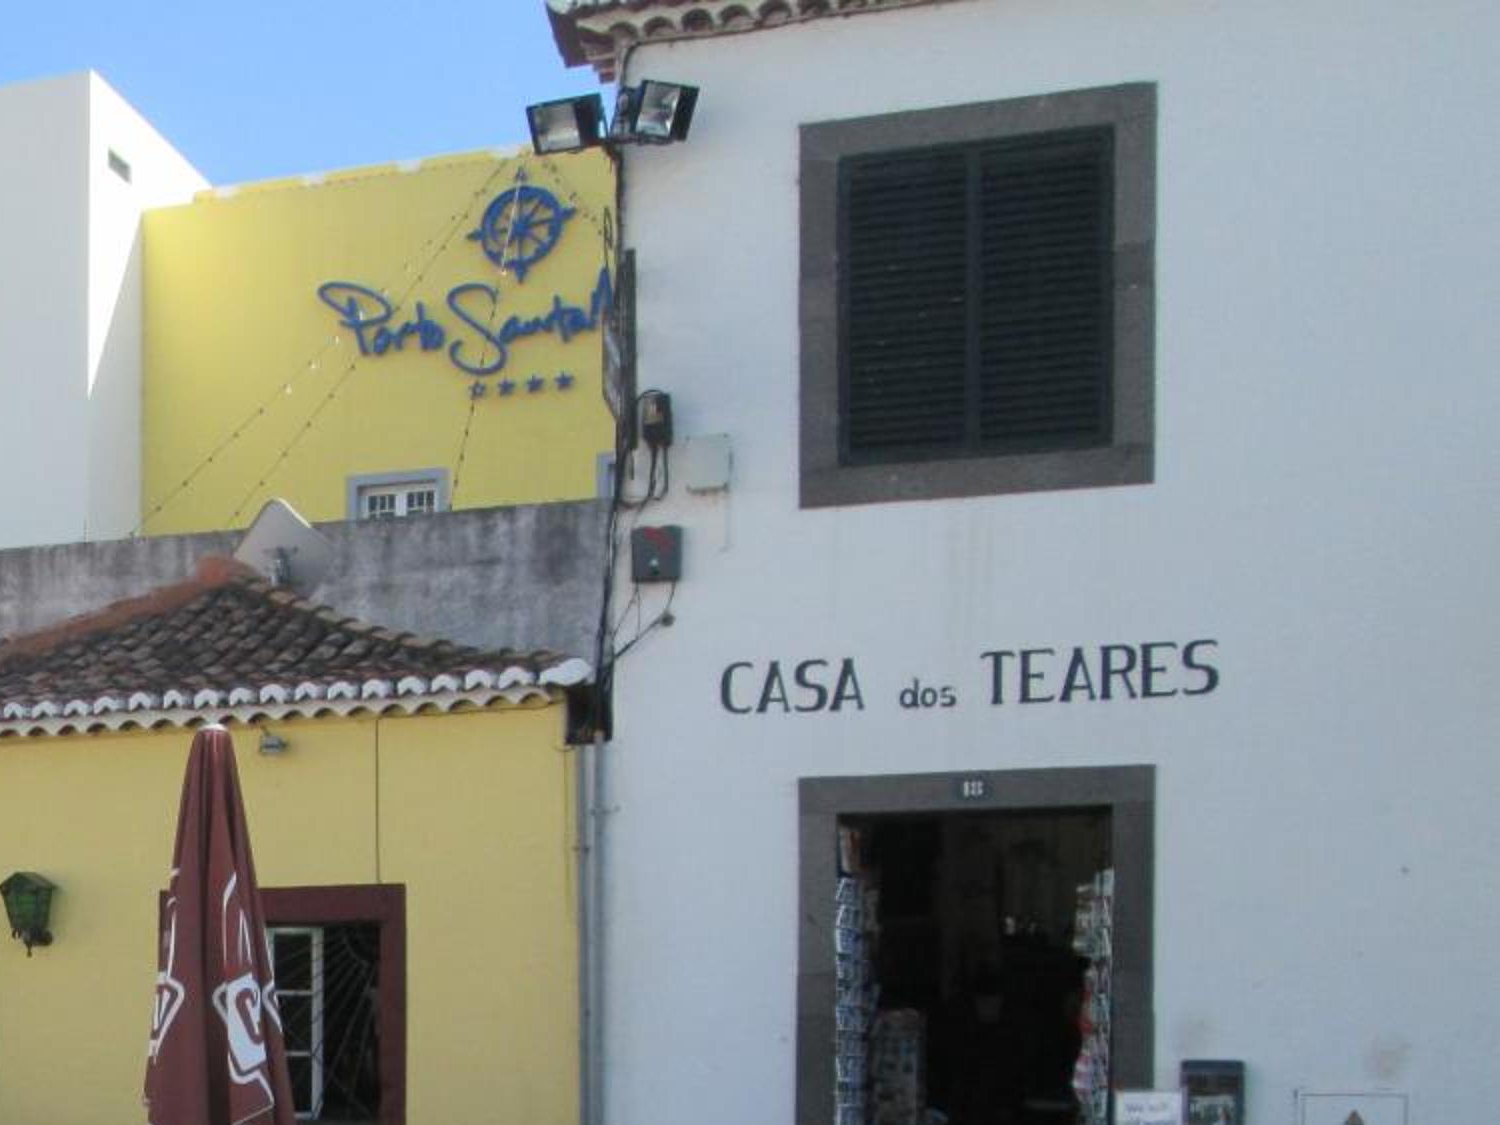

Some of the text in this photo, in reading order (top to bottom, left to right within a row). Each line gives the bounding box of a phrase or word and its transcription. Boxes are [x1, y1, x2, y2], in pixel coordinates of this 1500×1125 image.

[318, 282, 445, 356] Porto
[720, 639, 1220, 714] CASA dos TEARES
